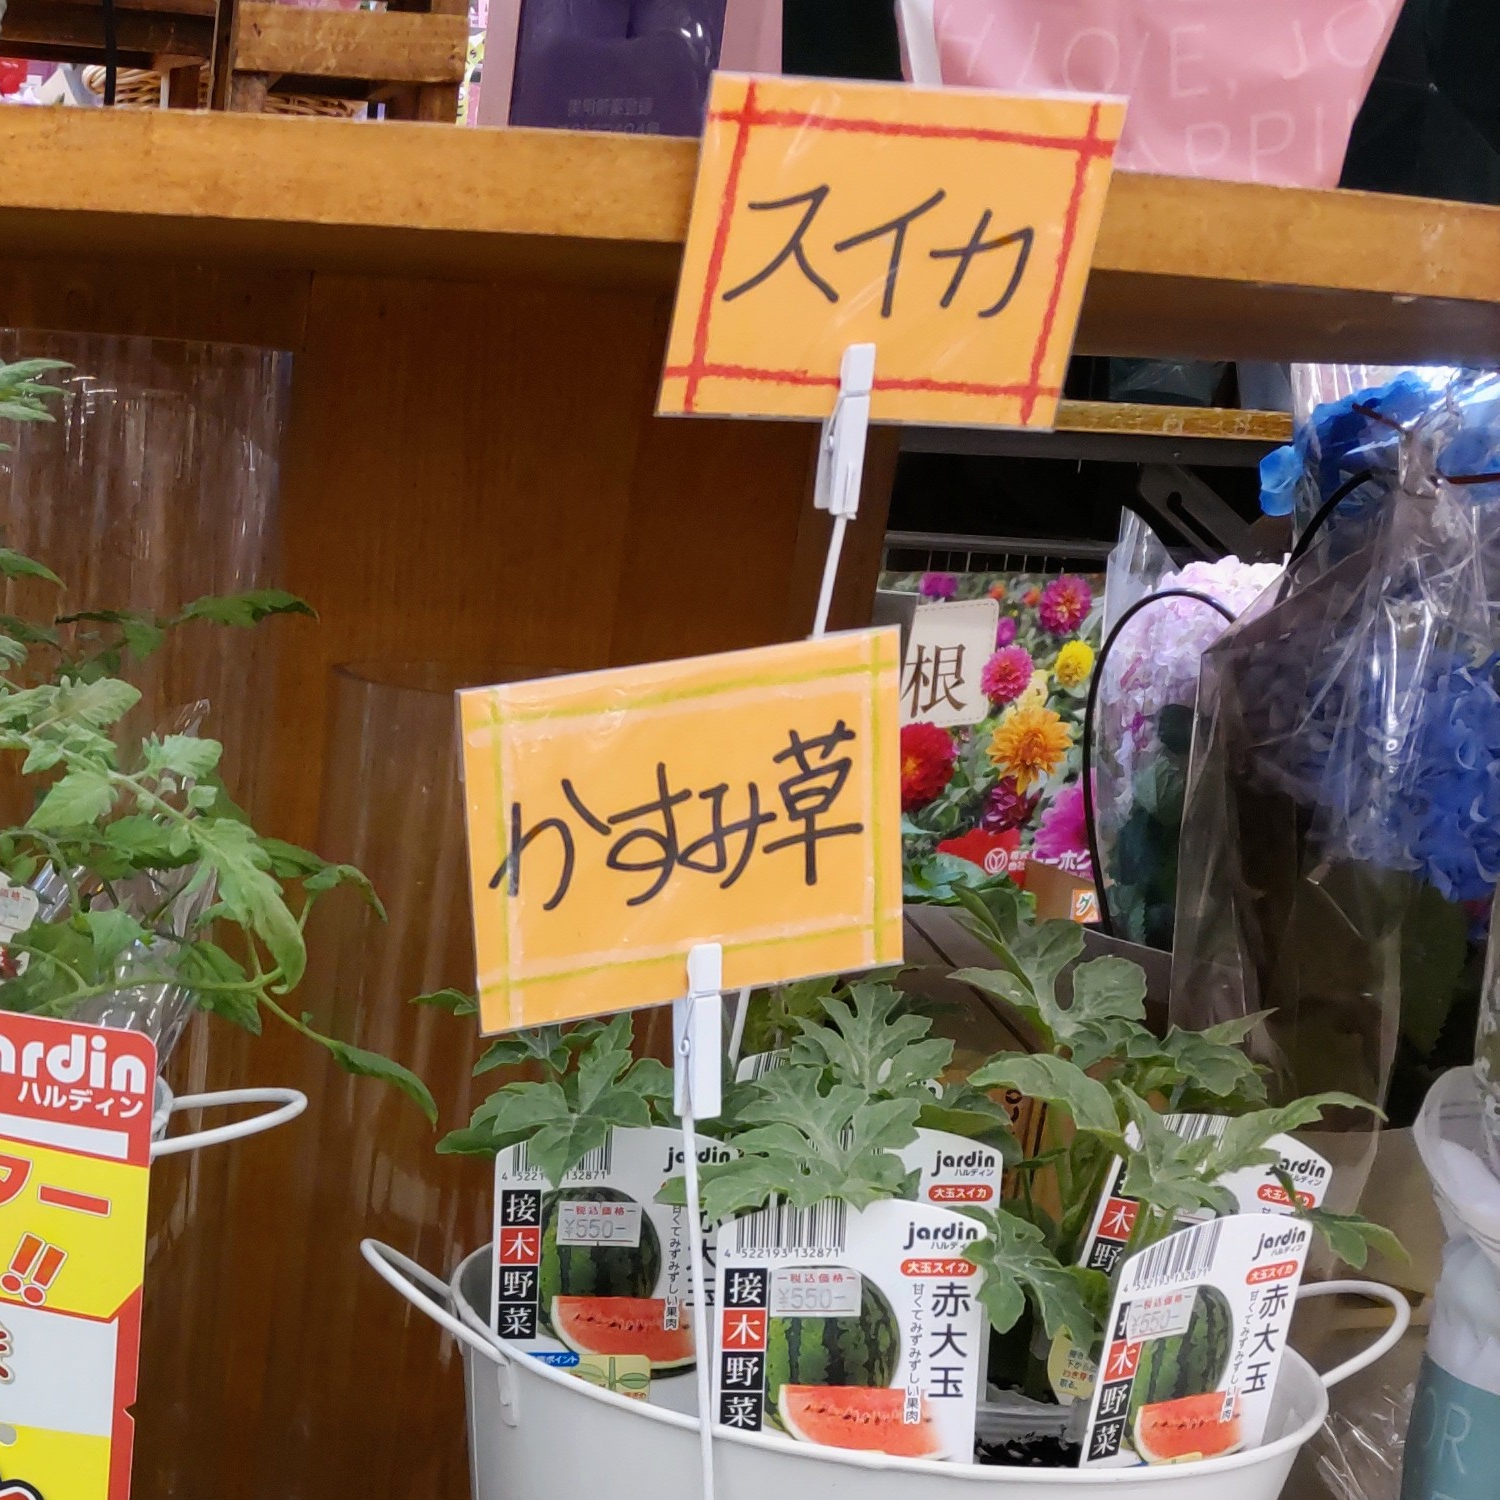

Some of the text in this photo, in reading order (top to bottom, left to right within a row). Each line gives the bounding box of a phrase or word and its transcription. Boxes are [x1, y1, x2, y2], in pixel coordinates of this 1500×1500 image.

[722, 183, 1035, 319] スイカ
[901, 642, 967, 718] 根
[488, 719, 864, 912] かすみ草
[18, 1081, 145, 1118] ハルディン
[663, 1146, 731, 1172] jadin
[931, 1150, 995, 1177] jardin
[954, 1167, 994, 1177] ハルディン
[934, 1187, 988, 1199] 大玉スイカ
[575, 1205, 625, 1216] 税込価格
[903, 1222, 979, 1250] jardin
[931, 1240, 968, 1250] ハルディ
[1252, 1228, 1306, 1261] jardin
[501, 1192, 537, 1336] 接木野菜
[741, 1247, 789, 1259] 522193
[794, 1247, 840, 1258] 132871
[907, 1261, 969, 1274] 大玉スイカ
[790, 1272, 845, 1284] 税込価格
[1250, 1264, 1294, 1281] 大玉スイカ
[725, 1272, 762, 1428] 接木野菜
[905, 1282, 925, 1422] 甘くてみずみずしい果肉
[928, 1281, 971, 1399] 赤大玉
[1242, 1284, 1288, 1396] 赤大玉
[1220, 1290, 1258, 1422] 甘くてみずみずしい果肉
